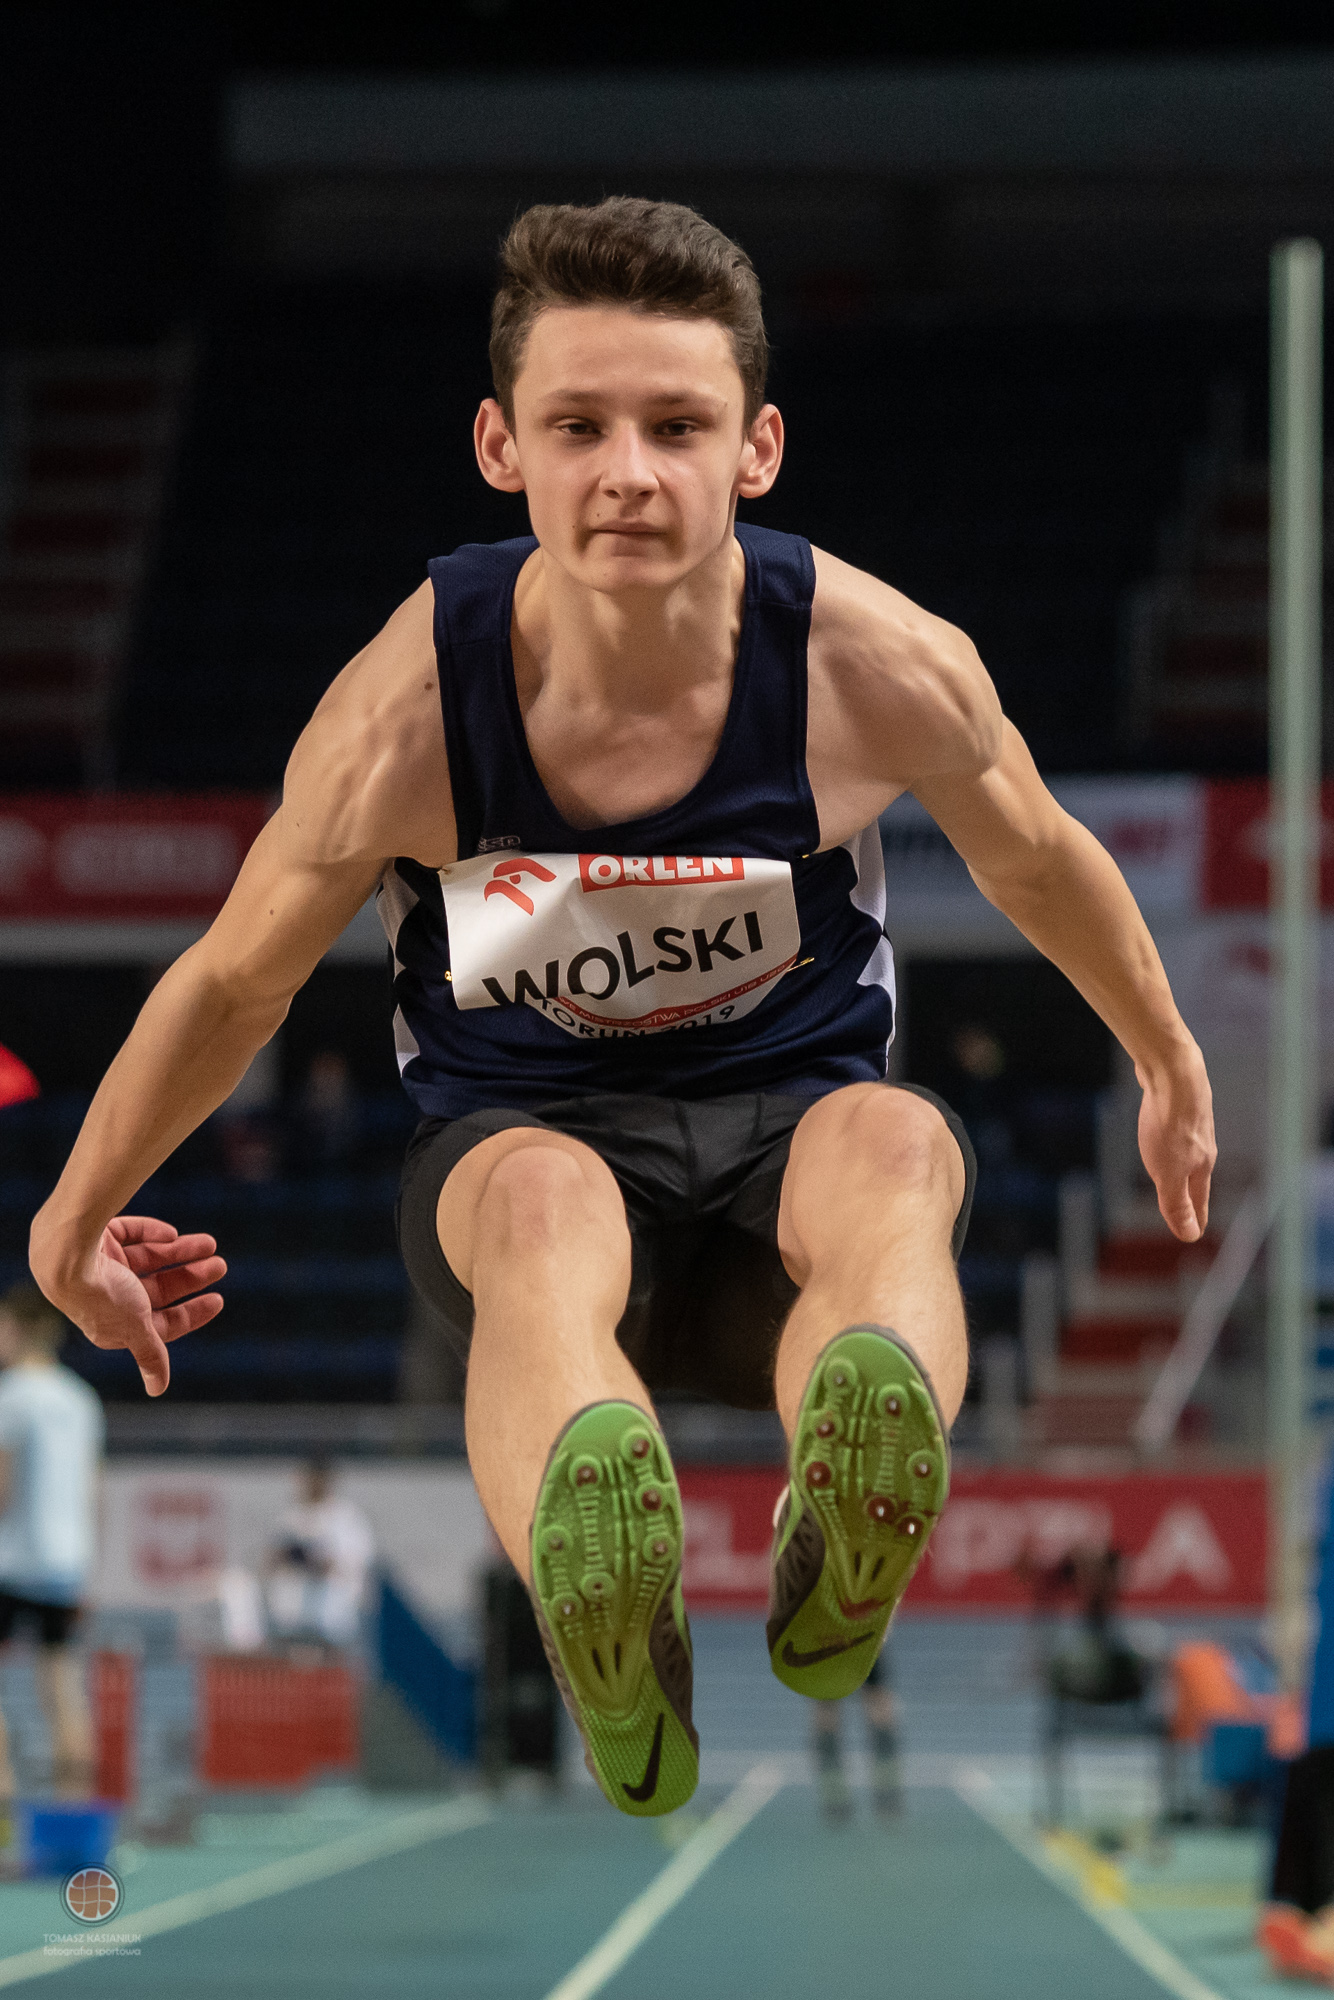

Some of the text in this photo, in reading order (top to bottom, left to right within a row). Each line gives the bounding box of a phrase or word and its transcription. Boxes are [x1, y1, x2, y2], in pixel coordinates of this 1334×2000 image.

[588, 855, 734, 885] ORLEN
[481, 911, 764, 1006] WOLSKI
[684, 993, 731, 1016] POLSKI
